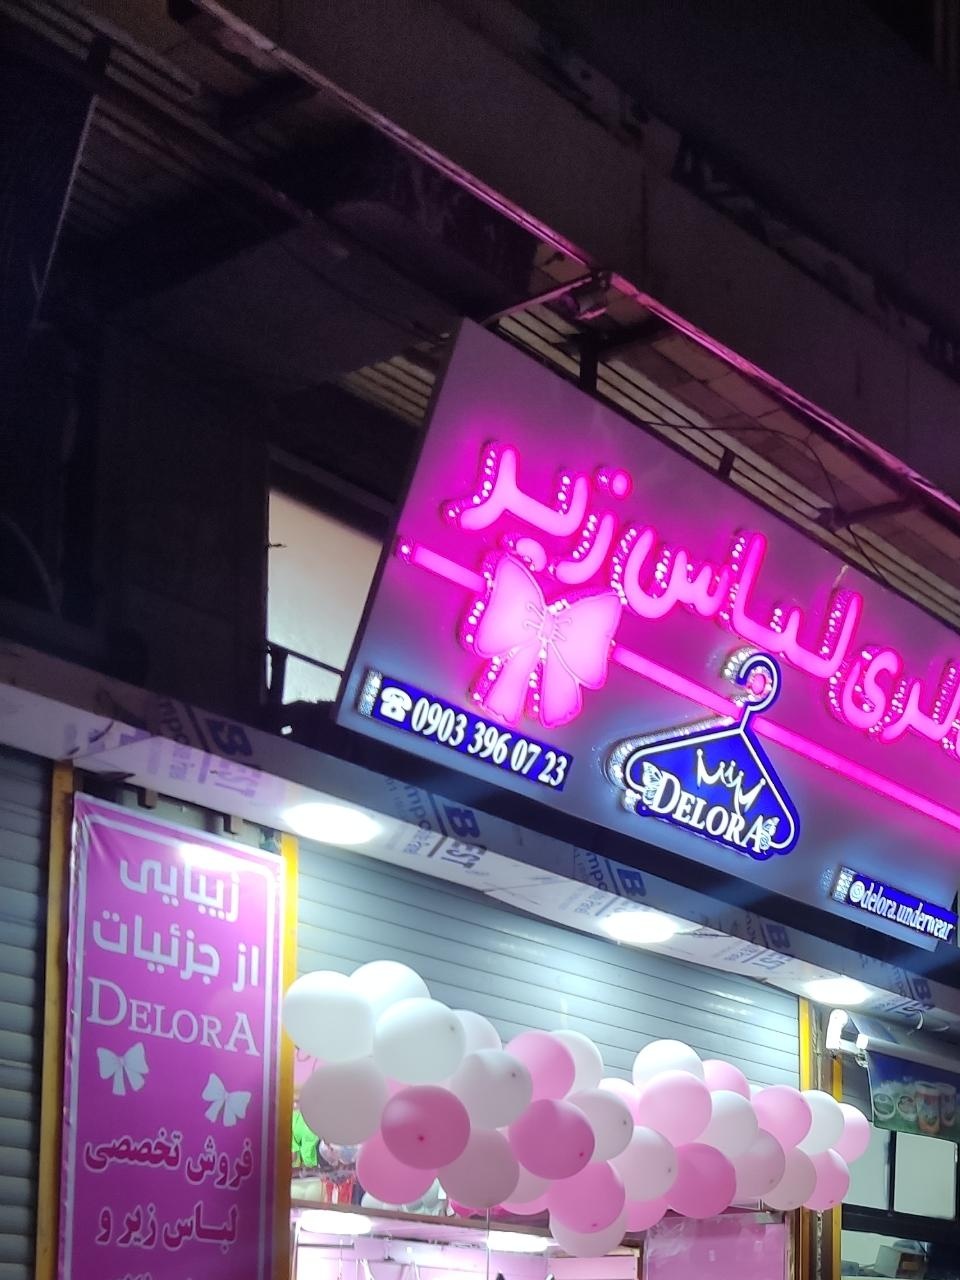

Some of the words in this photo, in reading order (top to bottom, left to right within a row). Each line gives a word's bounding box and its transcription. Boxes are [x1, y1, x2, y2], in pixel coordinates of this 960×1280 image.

[445, 441, 632, 585] زیر
[617, 531, 864, 696] لباس
[411, 697, 468, 746] 0903
[467, 721, 512, 764] 396
[511, 739, 541, 775] 07
[538, 751, 568, 786] 23
[651, 770, 765, 854] DELORA
[120, 857, 240, 923] زیبایی
[92, 909, 220, 984] جزئیات
[232, 942, 260, 993] از
[87, 976, 260, 1057] DELORA
[84, 1128, 182, 1172] تخصصی
[186, 1136, 253, 1189] فروش
[95, 1206, 112, 1245] و
[117, 1203, 158, 1247] زیر
[163, 1201, 238, 1253] لباس
